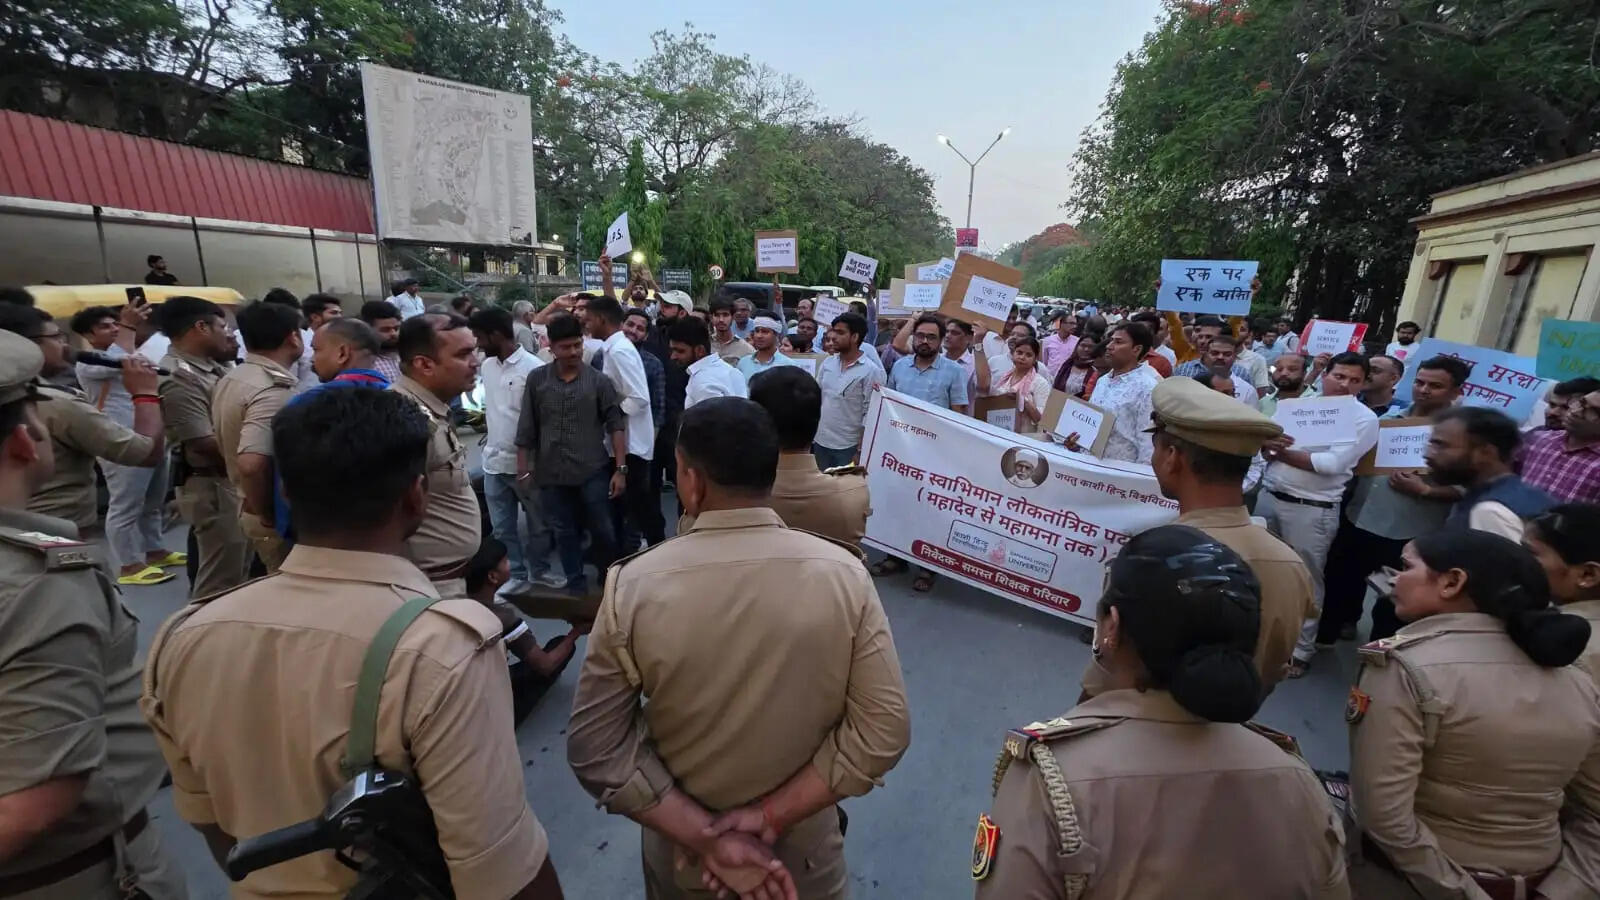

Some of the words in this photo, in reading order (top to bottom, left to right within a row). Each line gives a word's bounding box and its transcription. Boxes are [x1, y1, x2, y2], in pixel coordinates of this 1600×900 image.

[711, 268, 720, 277] 30
[1184, 267, 1212, 282] एक
[1221, 268, 1245, 281] पद
[973, 296, 984, 305] एक
[982, 286, 993, 296] एक
[996, 290, 1007, 299] पद
[1174, 286, 1204, 302] एक
[1212, 287, 1252, 301] व्यक्ति
[1488, 364, 1548, 392] सुरक्षा
[1459, 381, 1517, 408] सम्मान
[1291, 408, 1315, 417] महिला
[1319, 408, 1340, 418] सुरक्षा
[890, 419, 910, 433] जयतु
[911, 424, 938, 440] महामना
[1389, 445, 1408, 455] कार्य
[880, 452, 926, 482] शिक्षक
[929, 472, 1004, 507] स्वाभिमान
[1006, 495, 1100, 539] लोकतांत्रिक
[1055, 472, 1079, 487] जयतु
[1080, 479, 1105, 492] काशी
[1106, 484, 1128, 500] हिन्दू
[1128, 489, 1182, 511] विश्वविद्याल
[927, 491, 978, 518] महादेव
[980, 506, 996, 524] से
[998, 514, 1062, 547] महामना
[1064, 537, 1098, 558] तक
[1008, 557, 1049, 574] UNIVERSITY
[920, 543, 960, 567] निवेदक-
[962, 562, 992, 581] समस्त
[995, 571, 1031, 593] शिक्षक
[1033, 586, 1071, 607] परिवार
